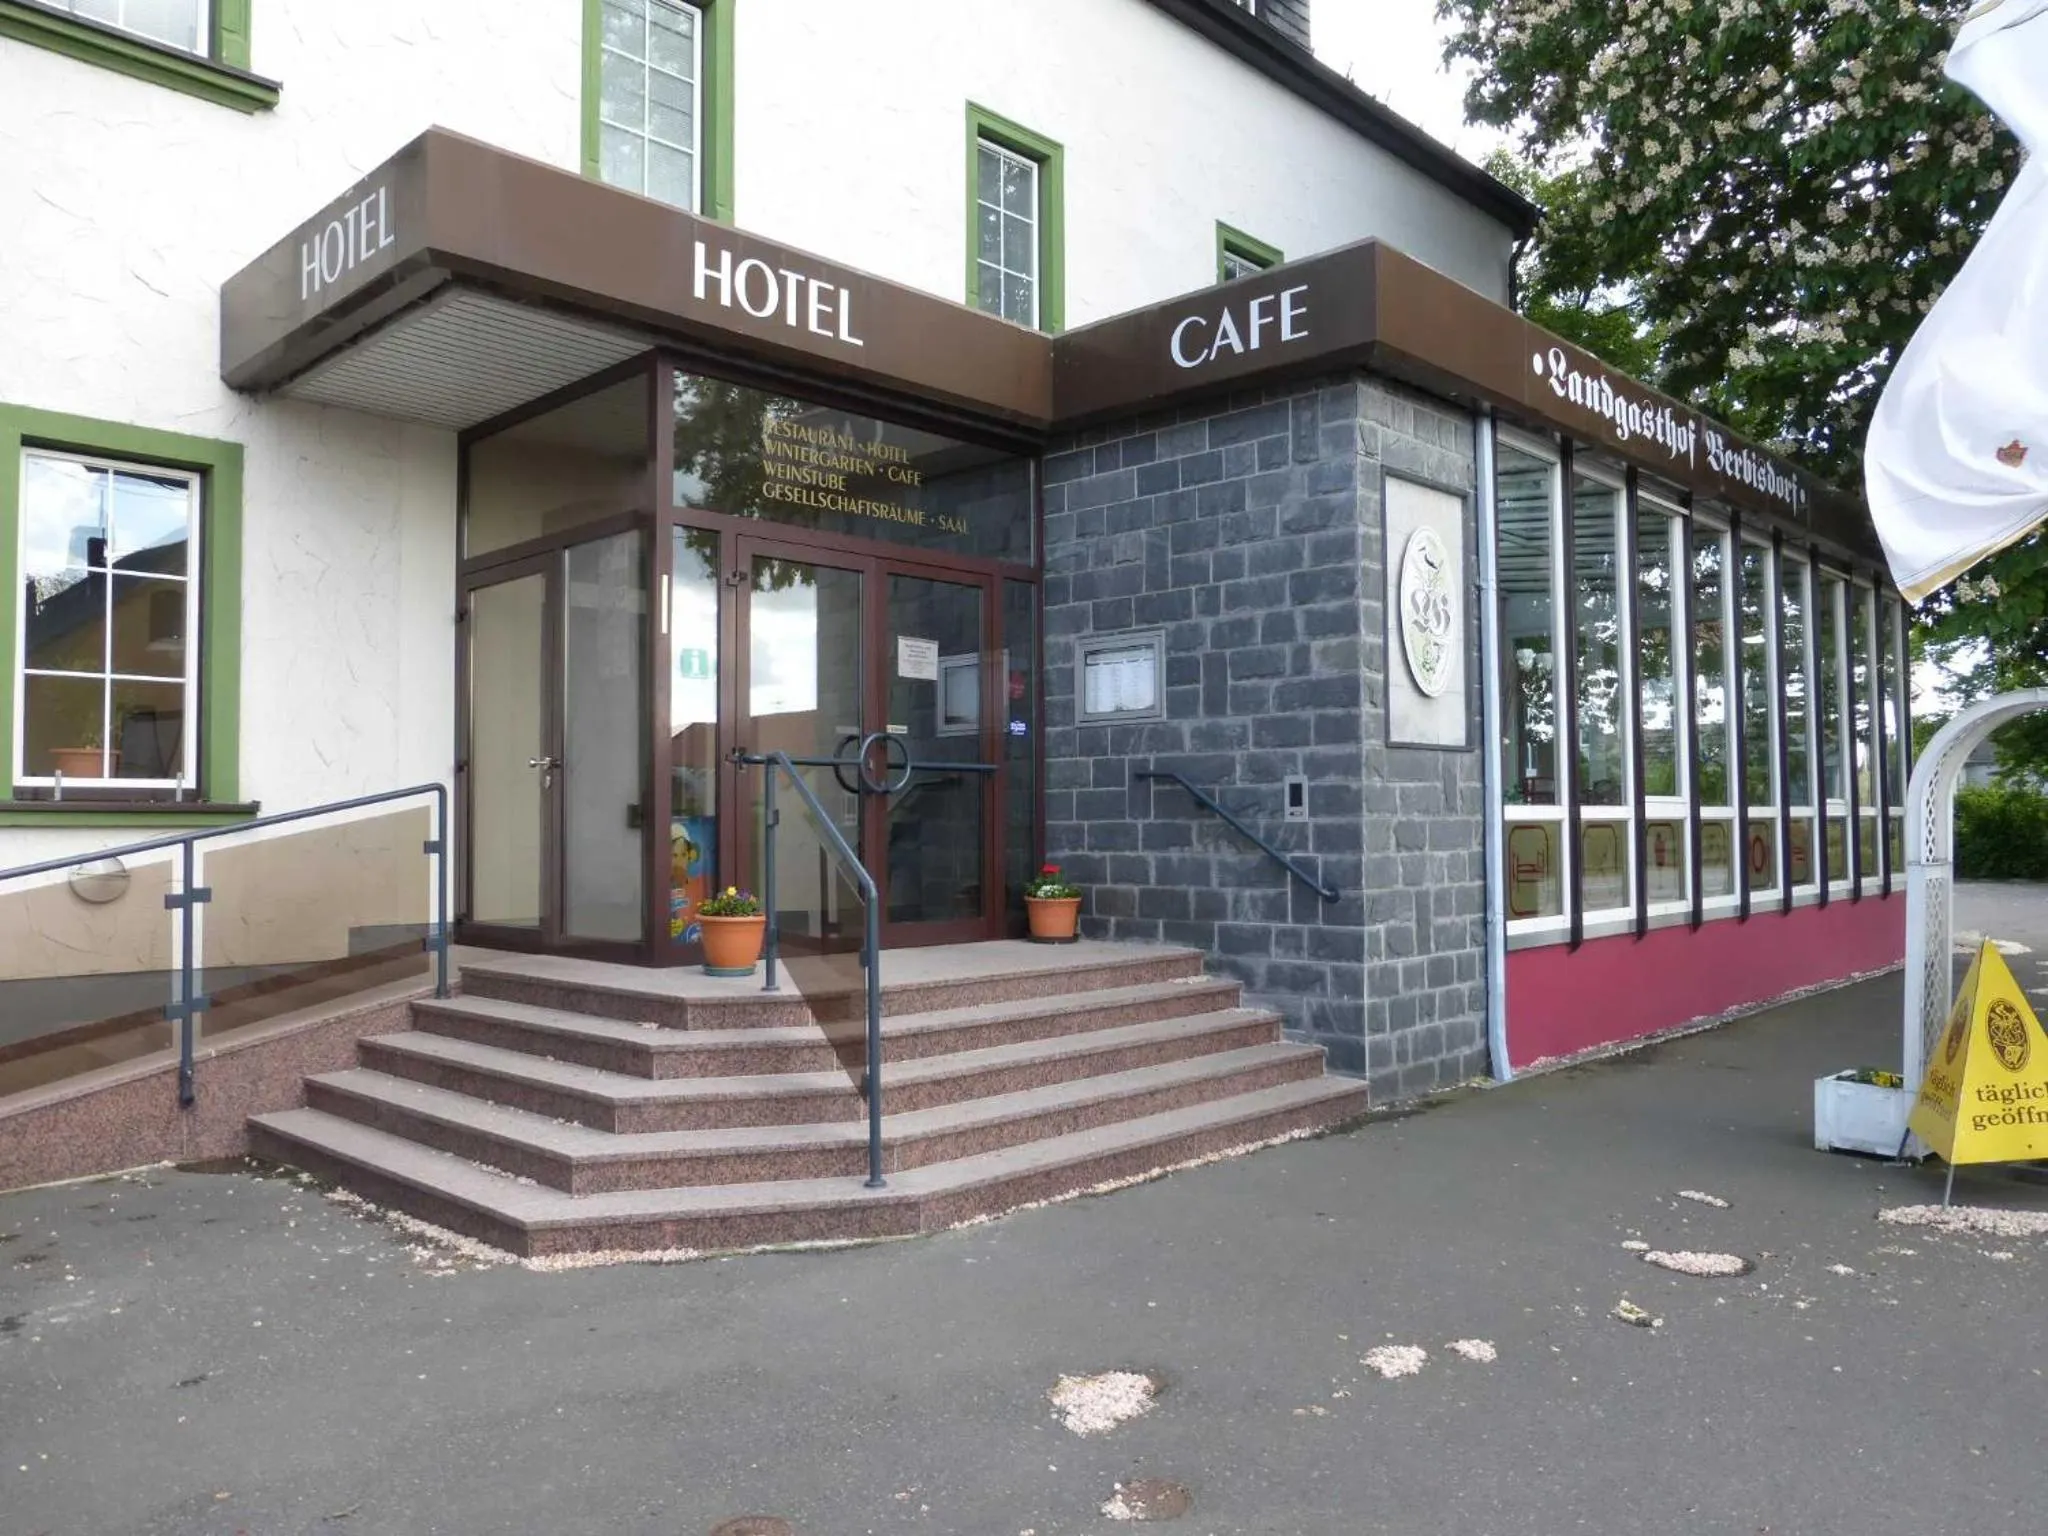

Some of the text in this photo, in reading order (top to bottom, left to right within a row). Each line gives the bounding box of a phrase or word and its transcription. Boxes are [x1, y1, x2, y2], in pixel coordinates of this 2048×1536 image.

[303, 186, 395, 300] HOTEL
[693, 240, 864, 346] HOTEL
[1170, 284, 1309, 368] CAFE
[763, 417, 910, 465] RESTAURANT HOTEL
[763, 436, 921, 488] WINTERGARTEN CAFE
[1547, 347, 1798, 517] Landgasthof Berbisdorf
[762, 481, 969, 535] GESELLSCHAFTSRÄUME SAAL
[763, 460, 848, 492] WEINSTUBE
